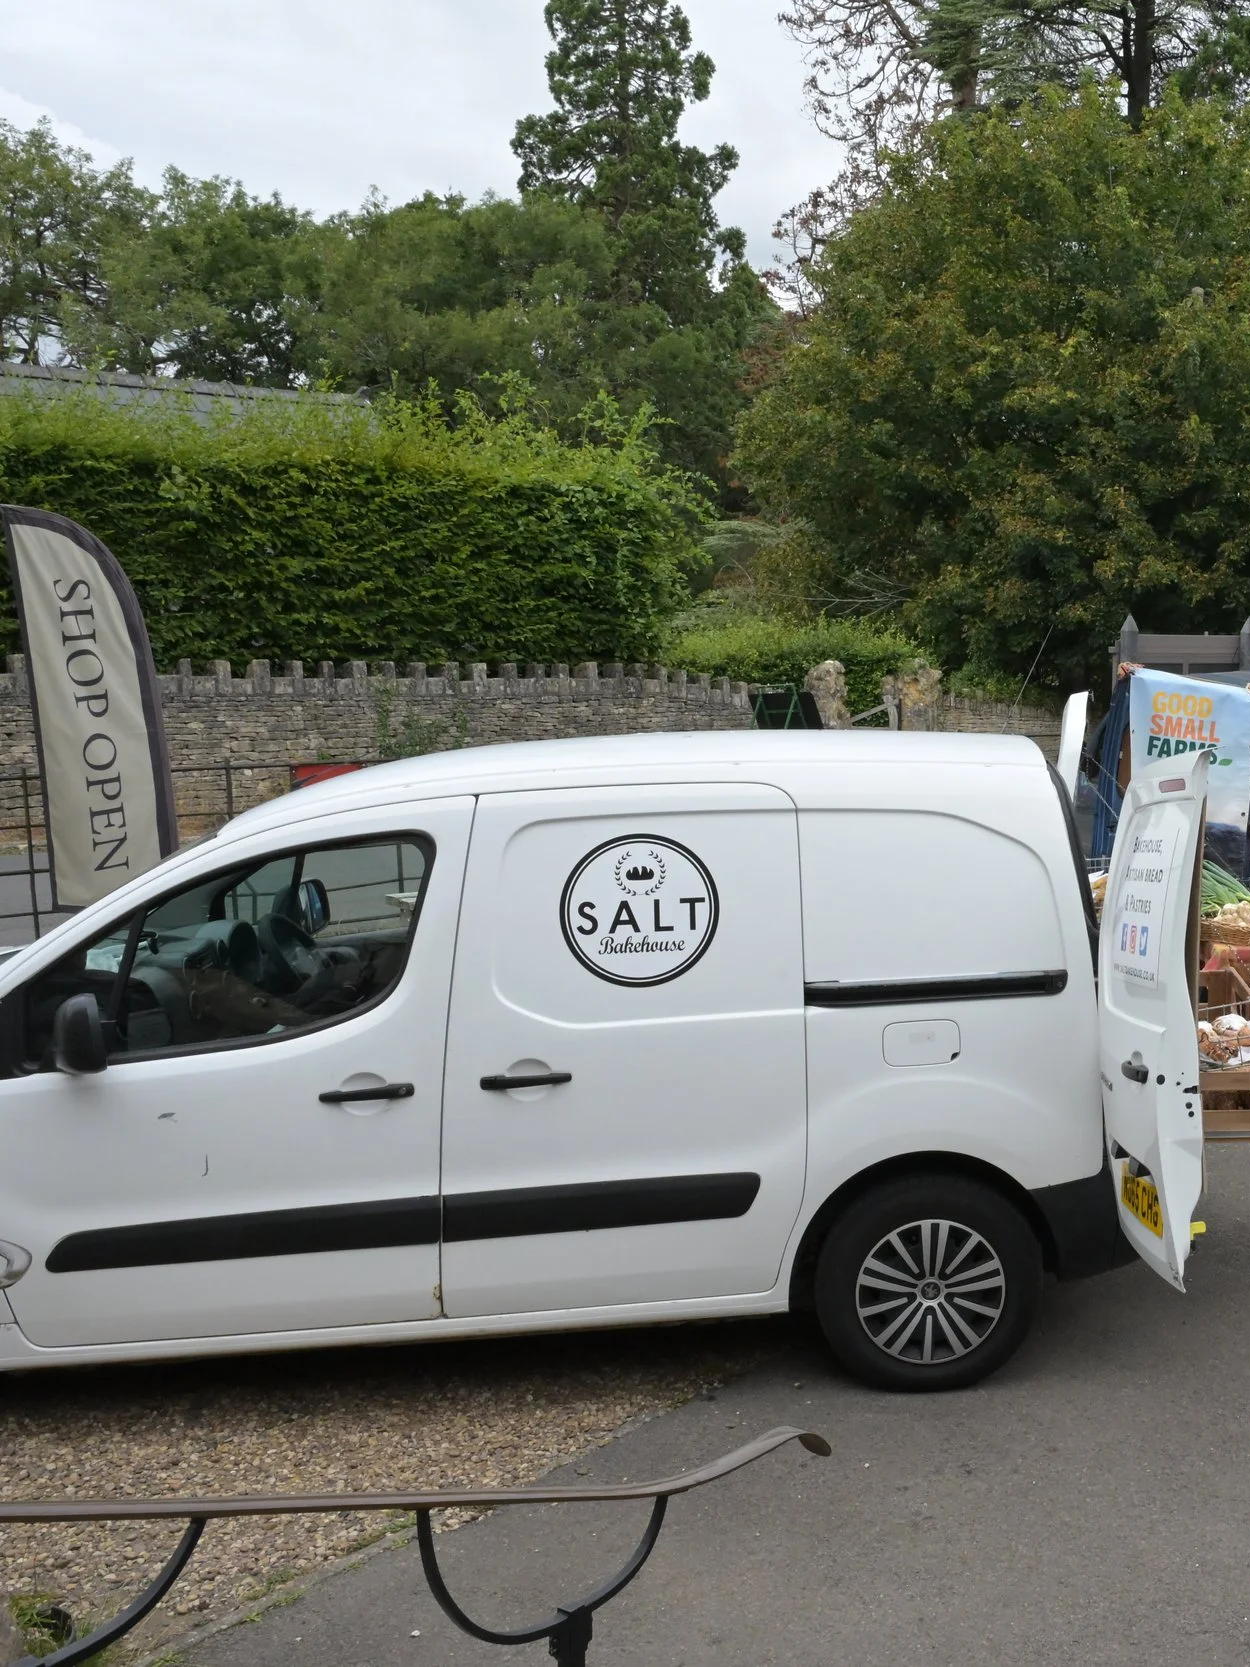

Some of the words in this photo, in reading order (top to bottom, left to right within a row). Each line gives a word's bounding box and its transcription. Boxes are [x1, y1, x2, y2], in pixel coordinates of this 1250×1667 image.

[1152, 691, 1213, 718] GOOD
[53, 578, 110, 719] SHOP
[82, 732, 129, 873] OPEN
[1150, 714, 1220, 743] SMALL
[576, 897, 706, 936] SALT
[598, 934, 686, 955] Bakehouse
